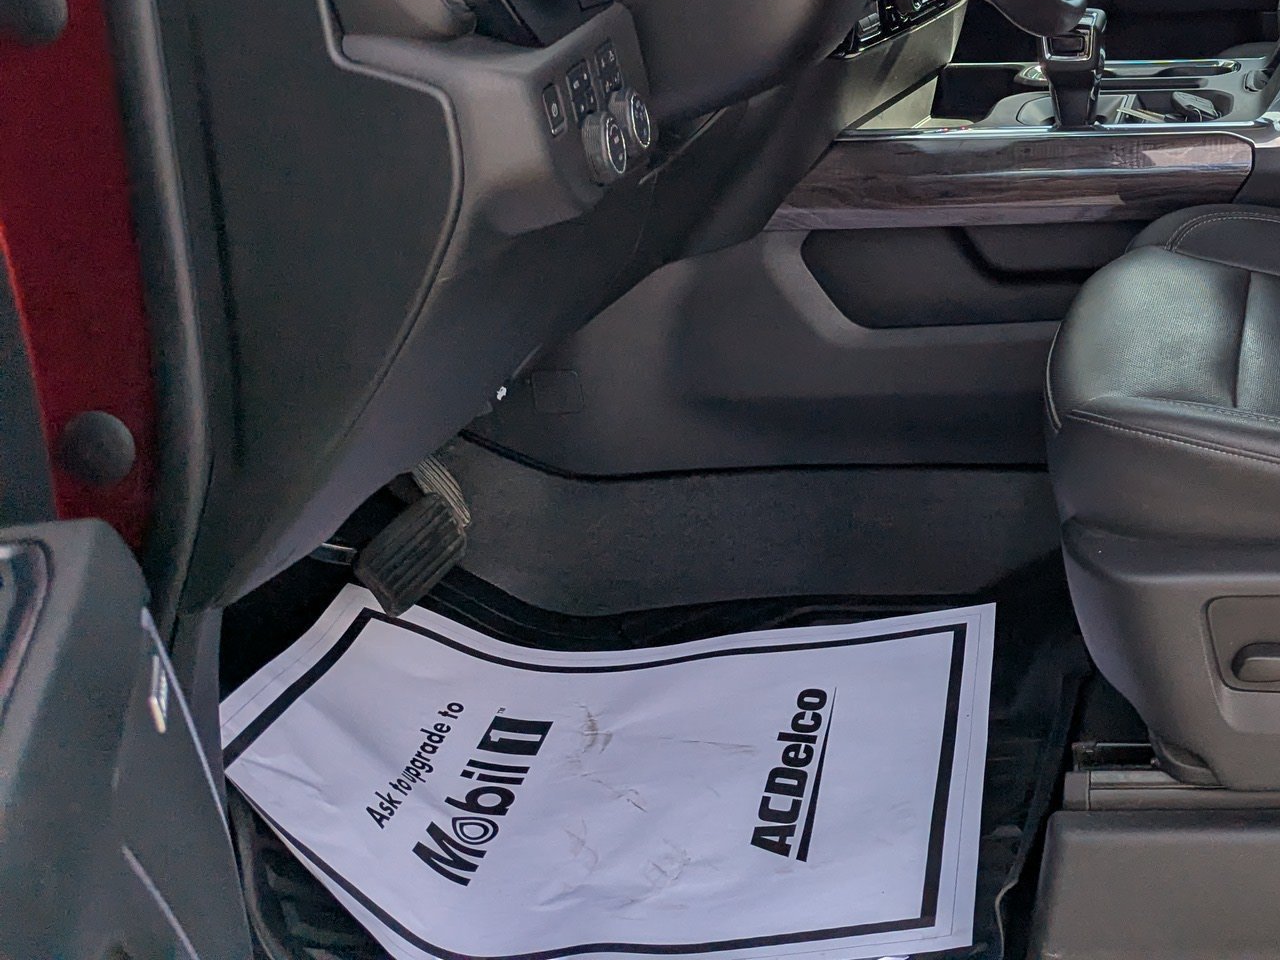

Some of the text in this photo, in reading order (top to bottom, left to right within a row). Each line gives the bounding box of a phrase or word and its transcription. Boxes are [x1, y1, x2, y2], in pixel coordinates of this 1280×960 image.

[365, 702, 464, 829] Ask to upgrade to
[412, 759, 531, 887] Mobil
[750, 688, 828, 858] ACDelco
